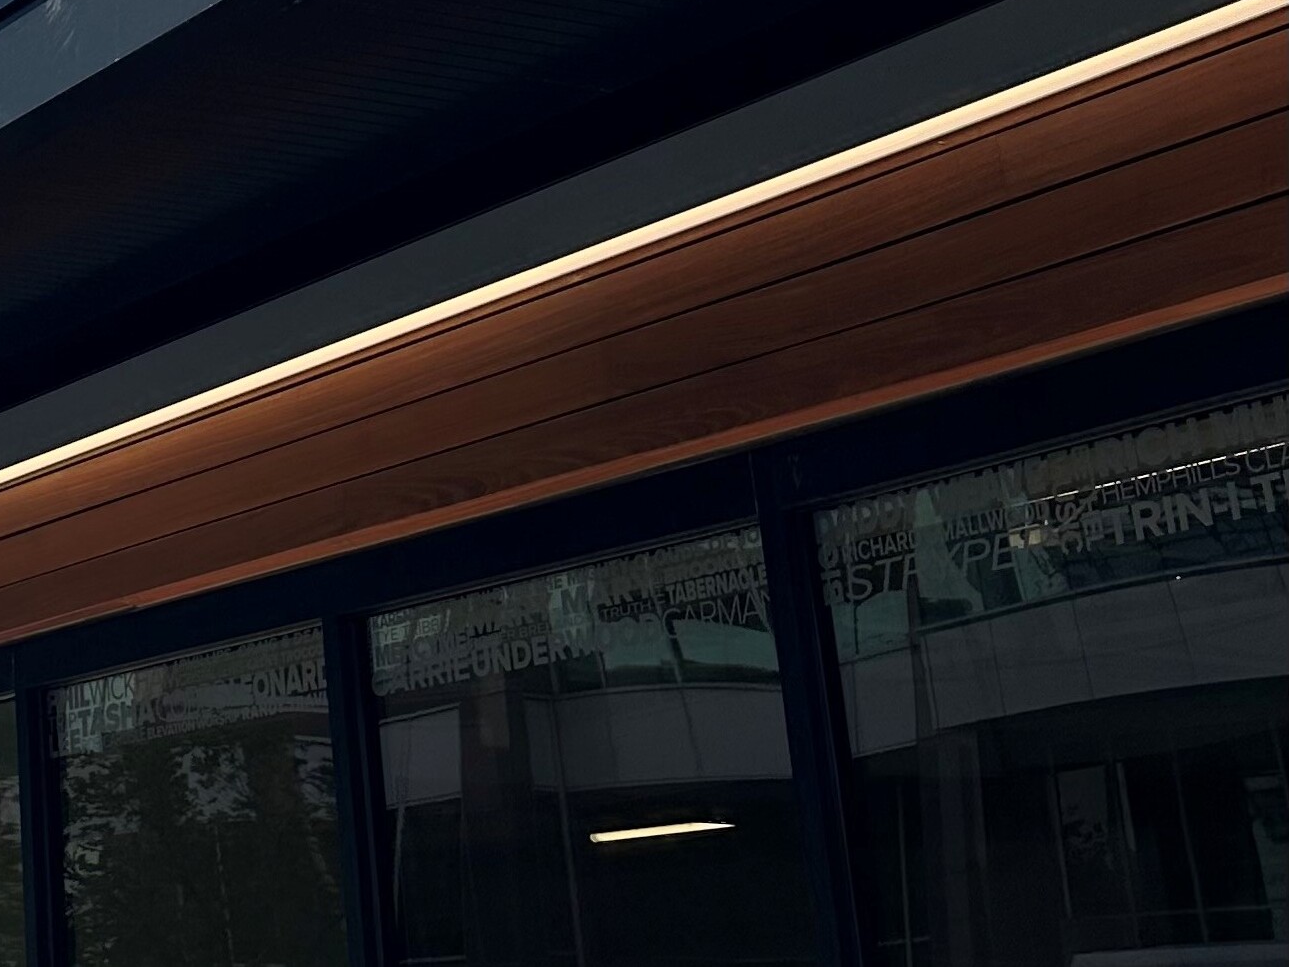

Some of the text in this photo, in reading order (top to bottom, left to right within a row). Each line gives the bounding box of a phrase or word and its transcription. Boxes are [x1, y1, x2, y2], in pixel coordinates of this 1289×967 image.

[1101, 455, 1241, 505] HEMPHILLS
[666, 562, 768, 605] TABERNACLE
[603, 599, 652, 619] TRUTH
